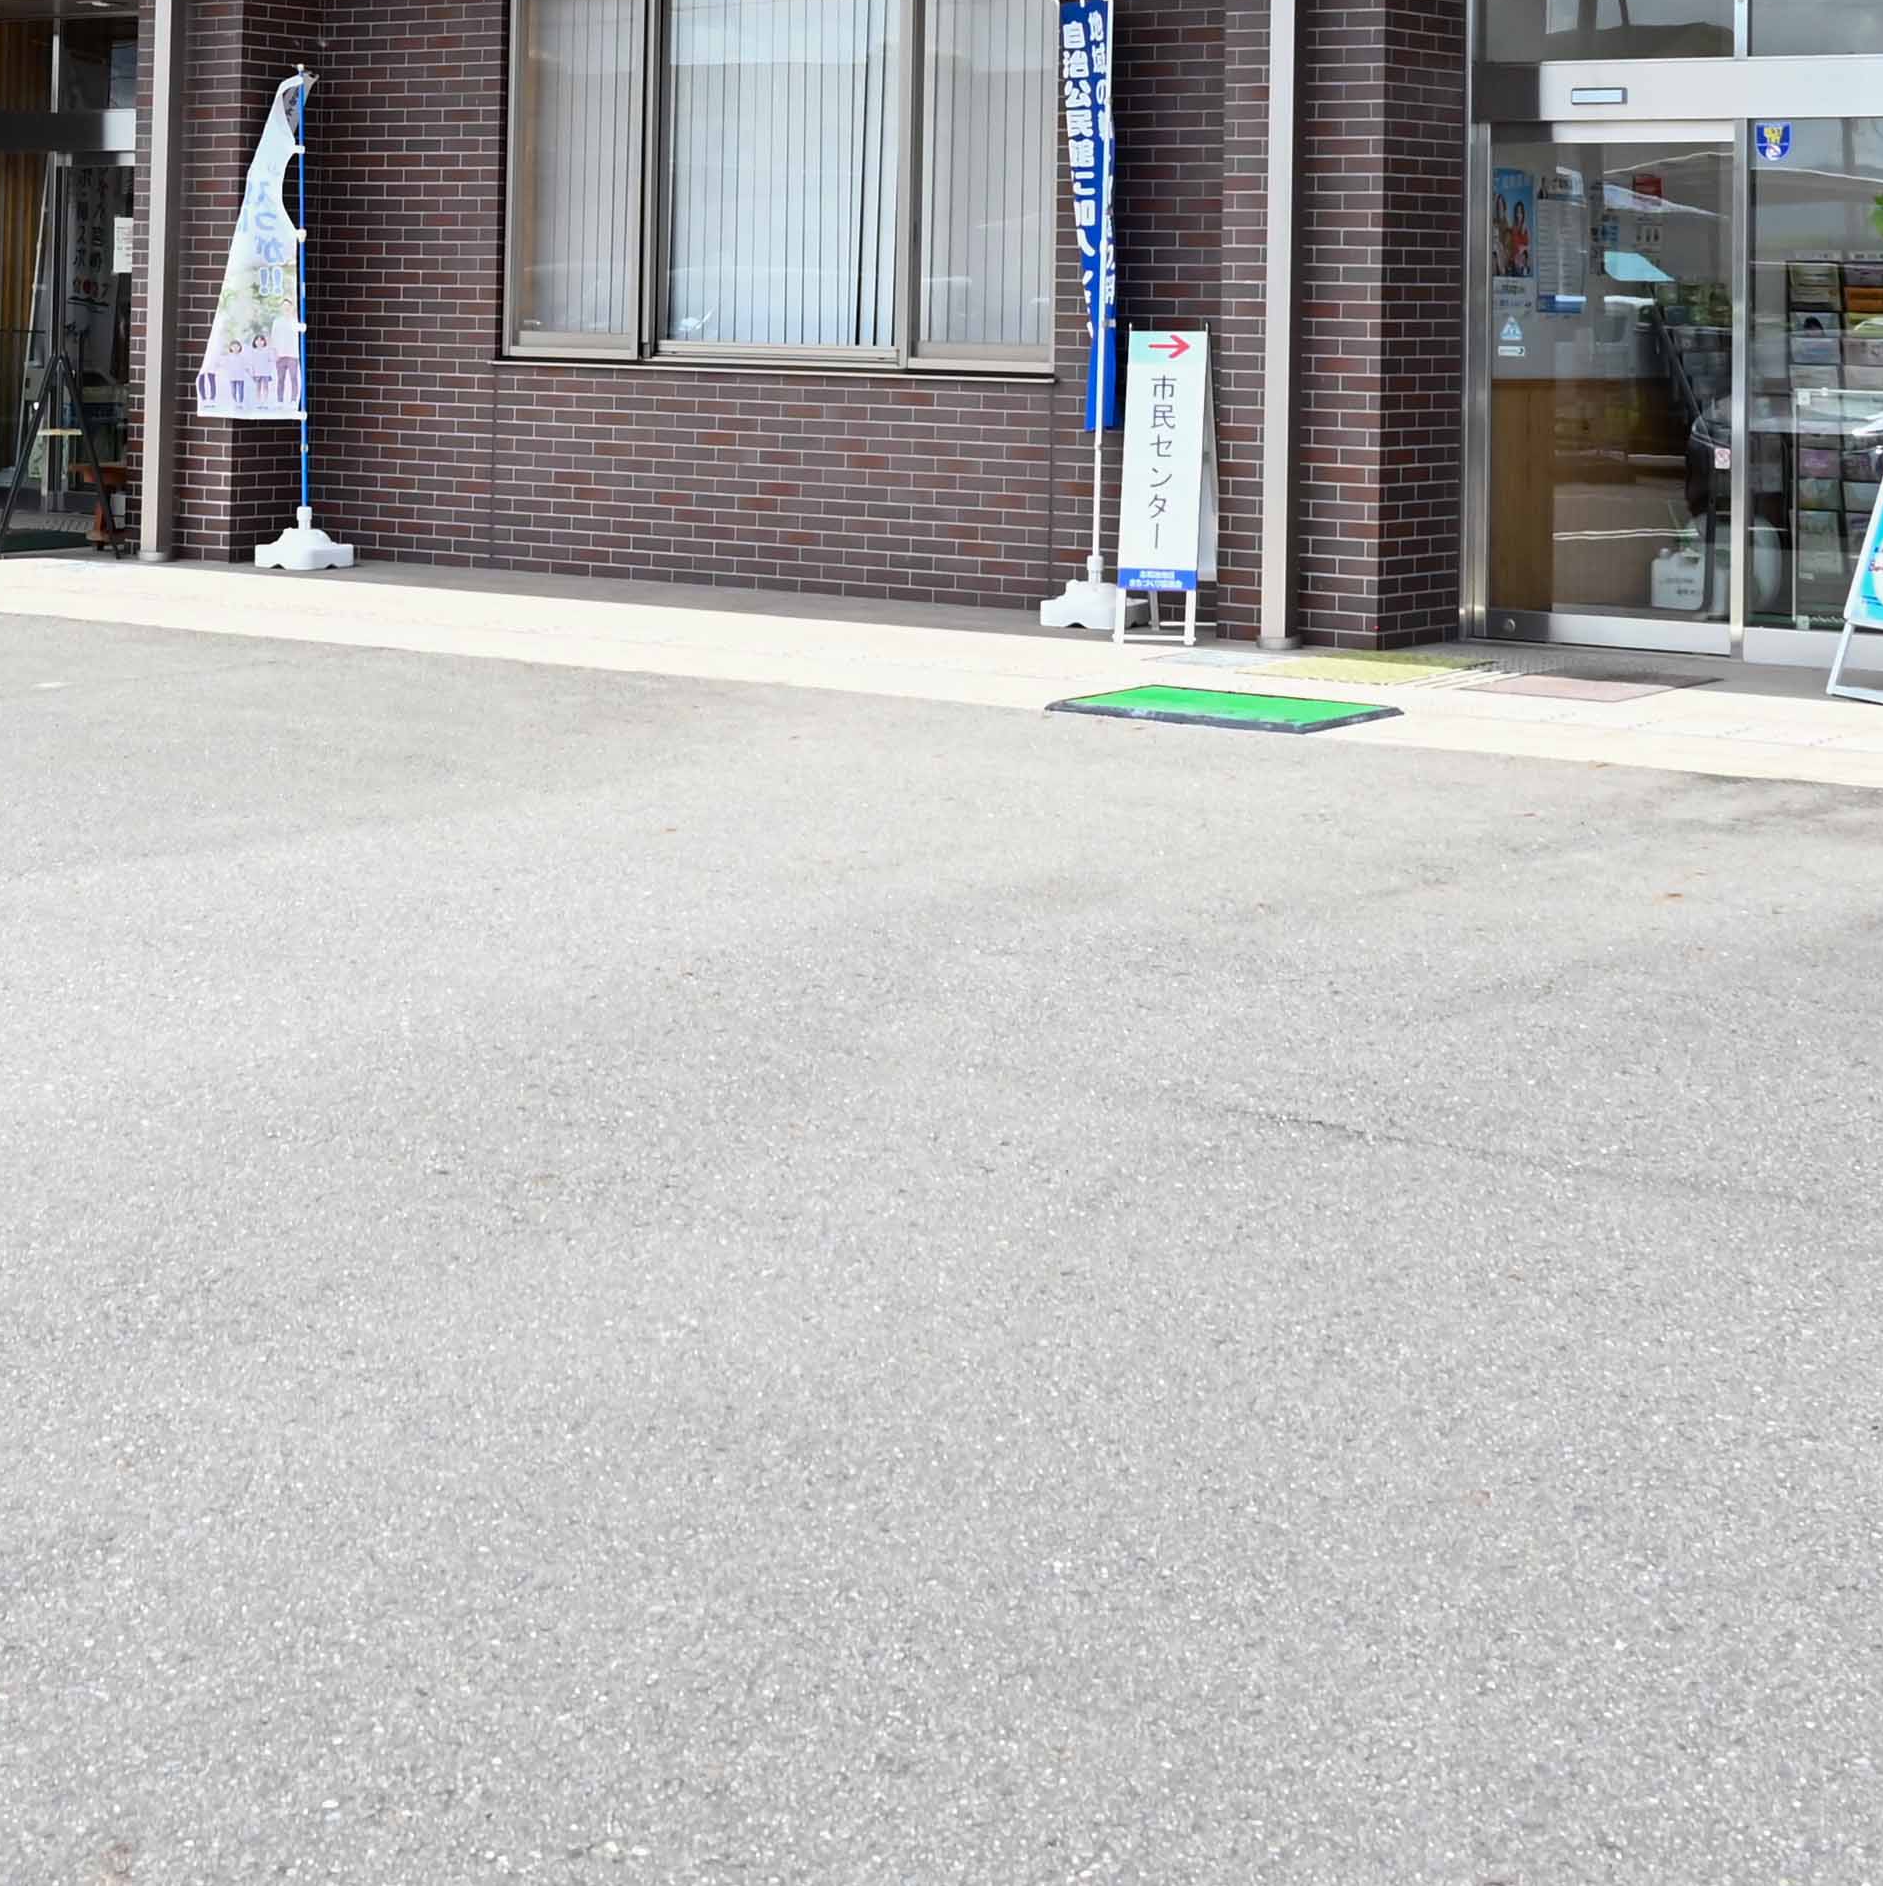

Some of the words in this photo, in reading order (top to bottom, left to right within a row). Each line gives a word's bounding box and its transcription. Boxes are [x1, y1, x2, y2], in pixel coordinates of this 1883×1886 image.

[1148, 375, 1178, 550] 市民センター
